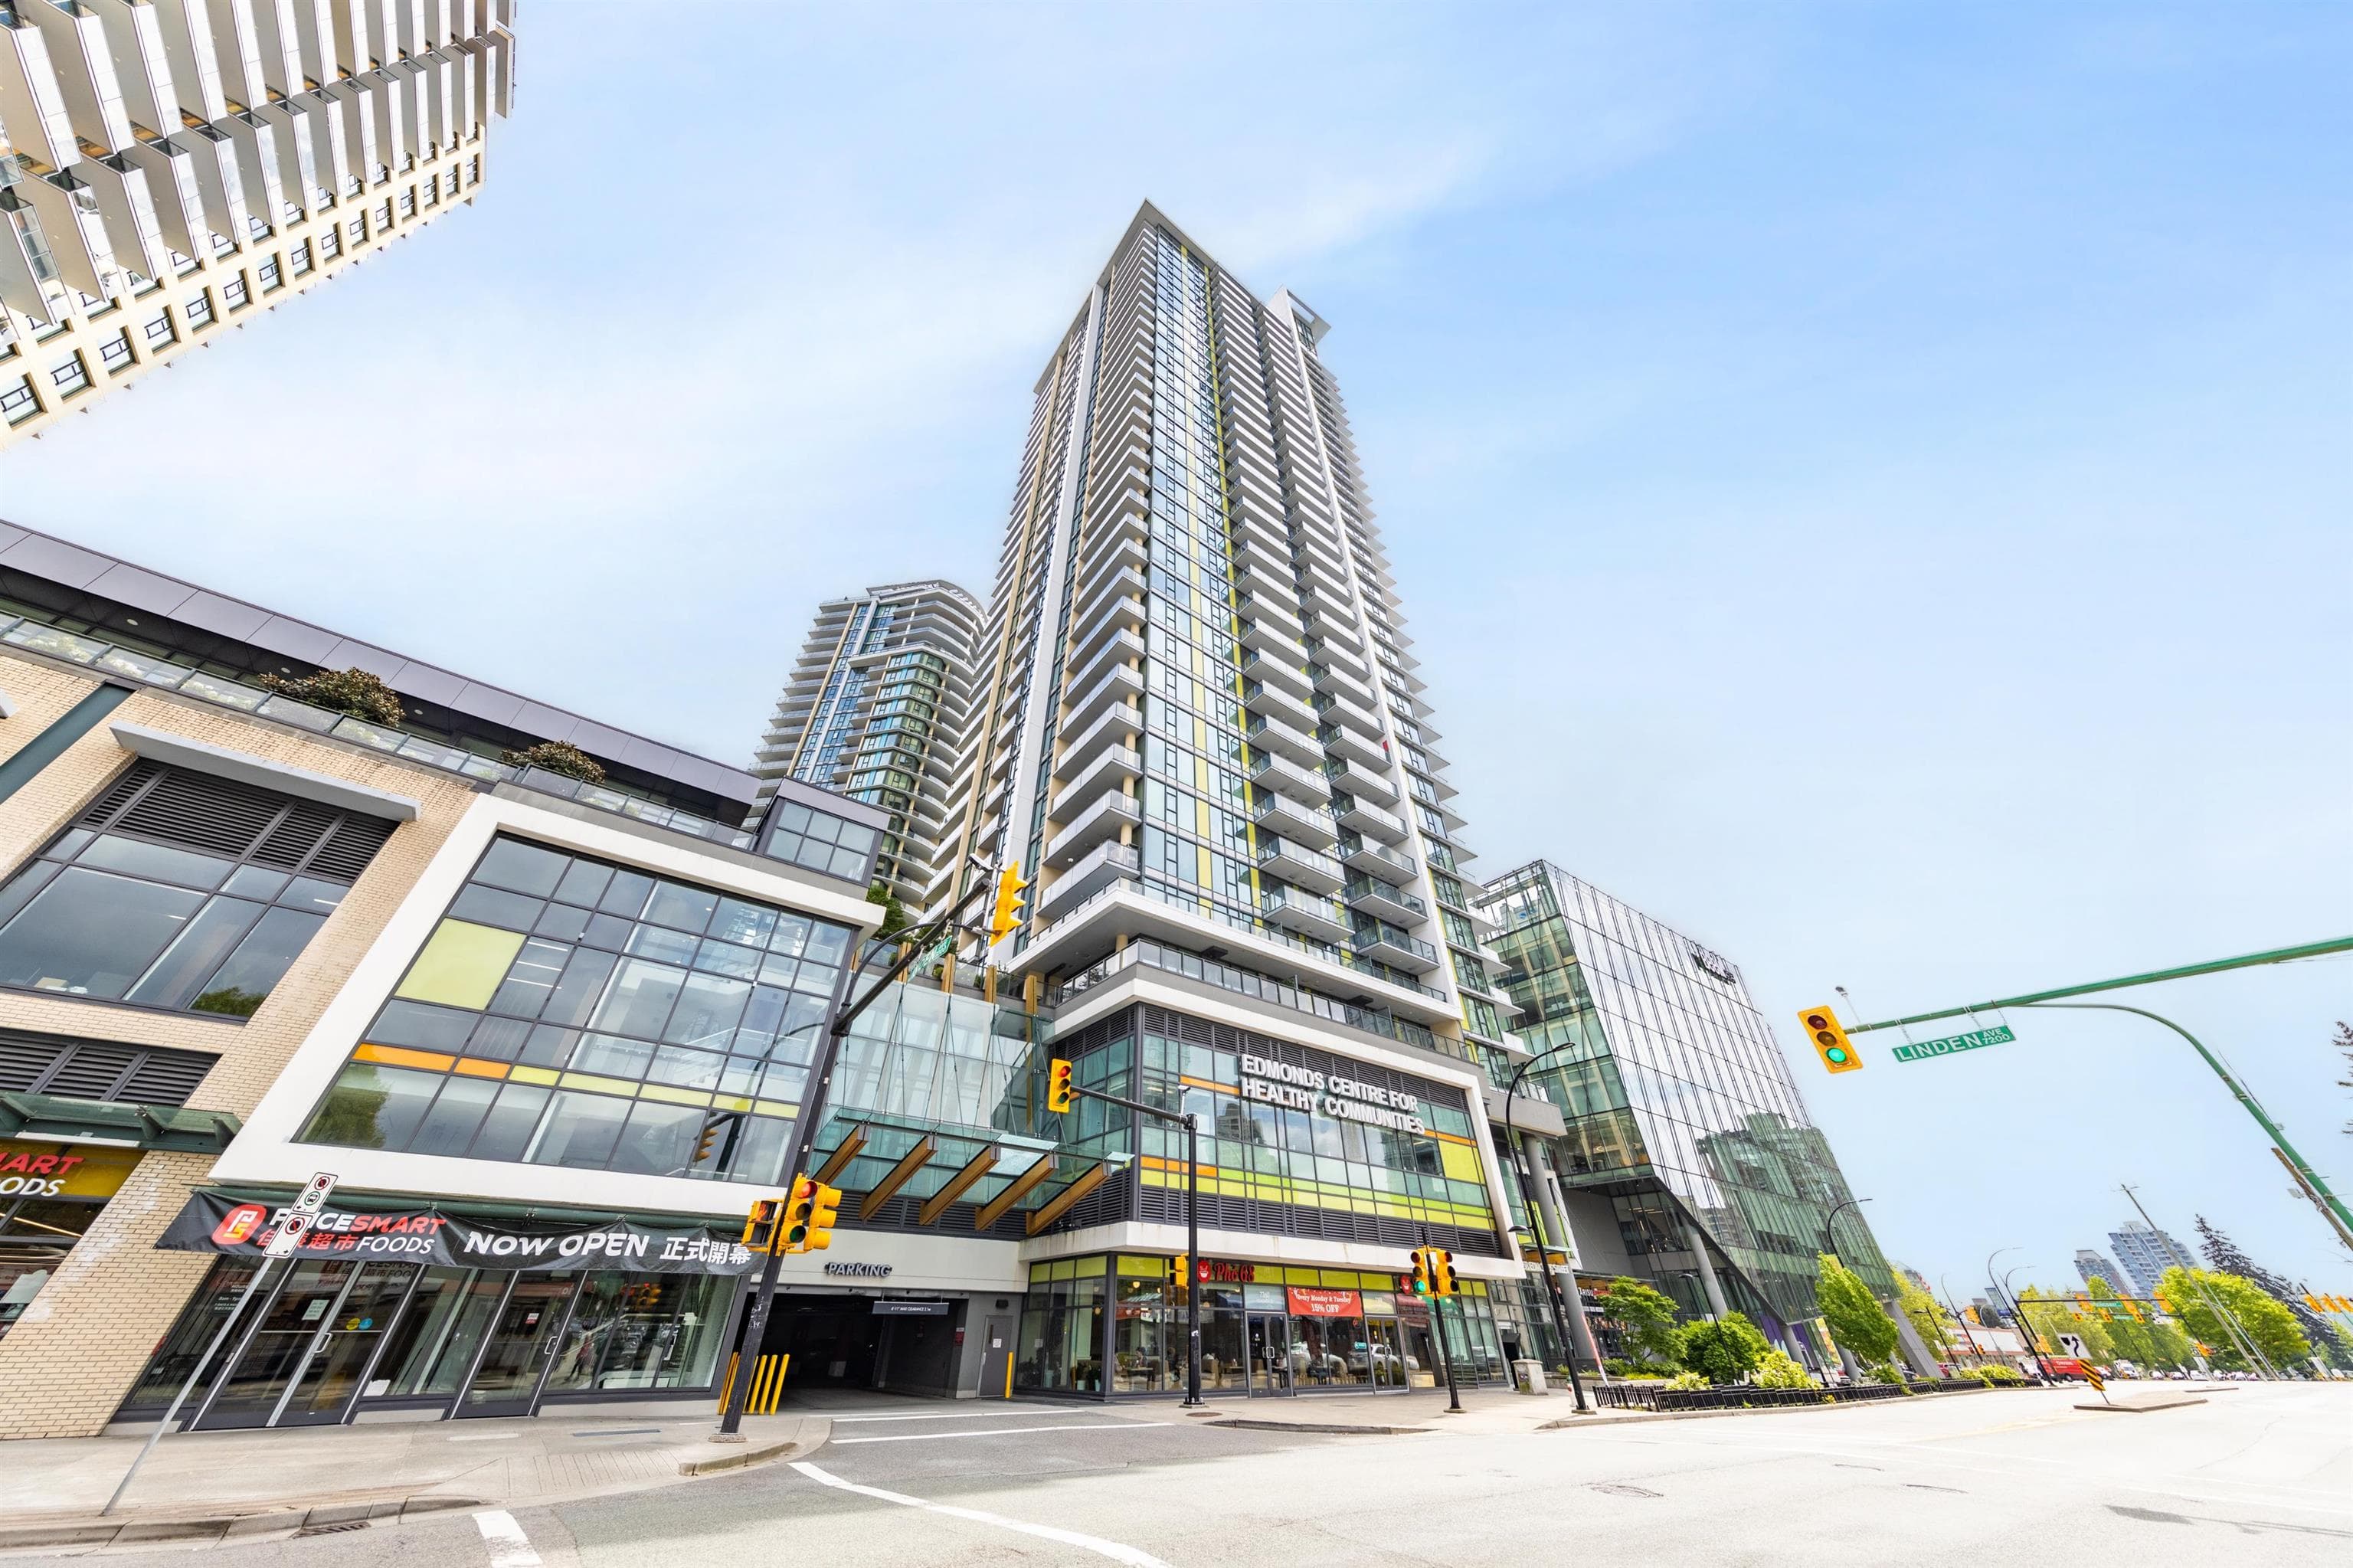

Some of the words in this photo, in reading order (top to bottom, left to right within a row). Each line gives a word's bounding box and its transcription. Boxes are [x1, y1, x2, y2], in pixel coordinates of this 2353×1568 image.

[1982, 1033, 2010, 1045] 7200
[1983, 1028, 2002, 1039] AVE
[1896, 1033, 1984, 1061] LINDEN
[1242, 1054, 1325, 1089] EDMONDS
[1328, 1075, 1389, 1105] CENTRE
[1388, 1090, 1420, 1113] FOR
[1242, 1077, 1318, 1112] HEALTHY
[1324, 1097, 1425, 1135] COMMUNITIES
[0, 1151, 86, 1175] ART
[269, 1207, 447, 1235] PICESMART
[355, 1236, 435, 1255] FOODS
[463, 1231, 555, 1256] NOW
[558, 1232, 650, 1257] OPEN
[659, 1236, 752, 1265] 正式開幕
[827, 1262, 892, 1278] PARKING
[1239, 1263, 1255, 1283] 68
[1294, 1293, 1310, 1302] Every
[1311, 1295, 1328, 1303] Monday
[1334, 1296, 1352, 1305] Tuesday
[1311, 1303, 1325, 1312] 15%
[1325, 1304, 1340, 1313] OFF
